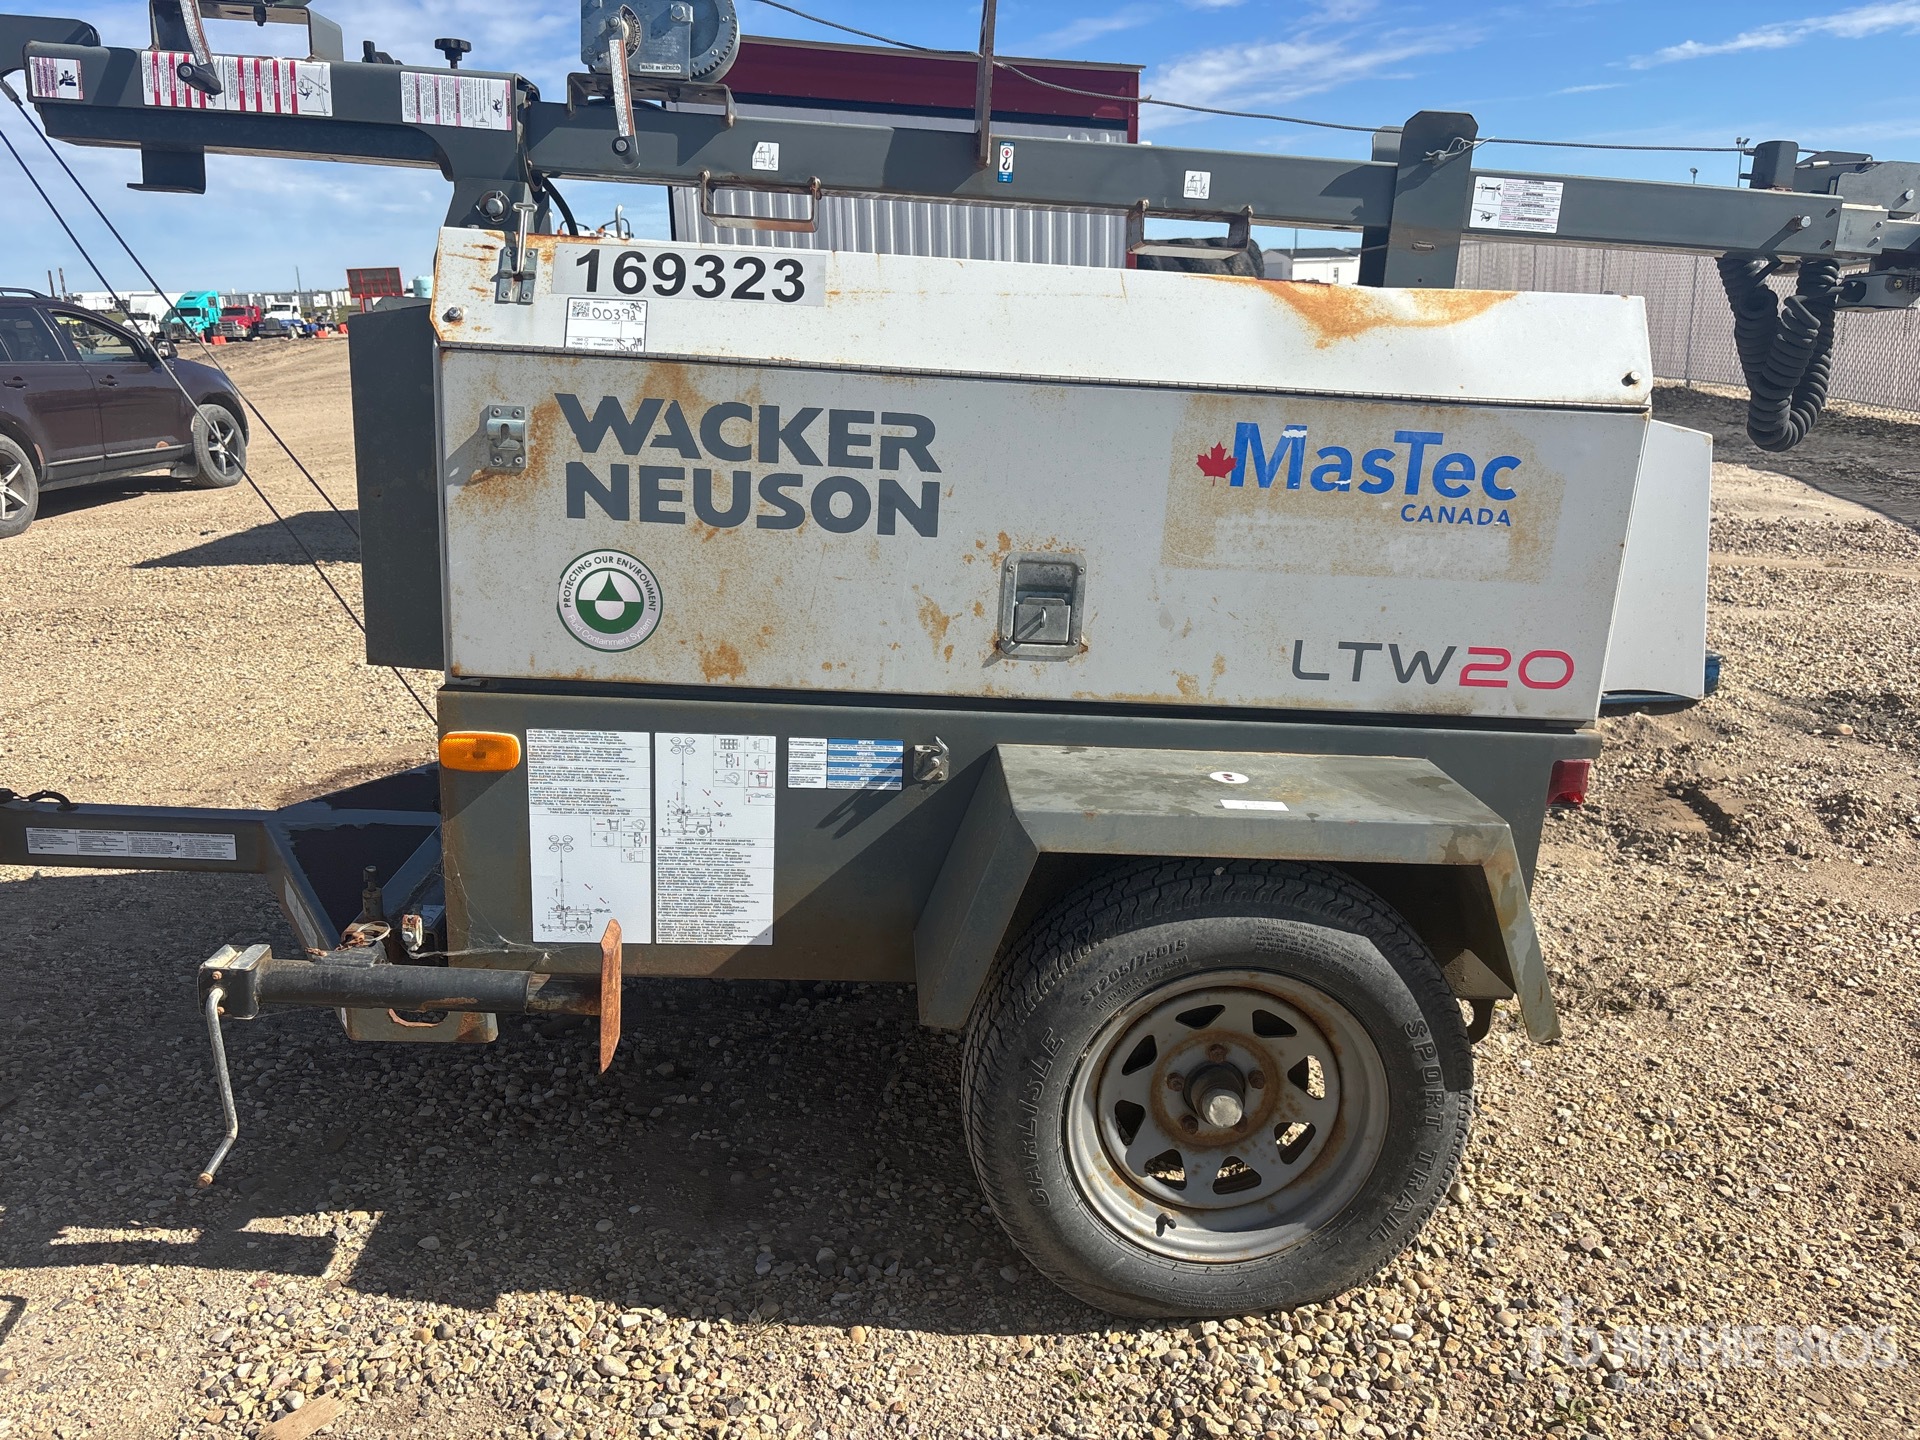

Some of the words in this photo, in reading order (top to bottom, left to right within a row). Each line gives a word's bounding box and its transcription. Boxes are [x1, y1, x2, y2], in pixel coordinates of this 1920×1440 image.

[632, 20, 640, 45] CAUTION
[576, 248, 806, 302] 169323
[554, 392, 942, 473] WACKER
[1230, 422, 1522, 501] MasTec
[565, 461, 941, 538] NEUSON
[1400, 504, 1512, 527] CANADA
[563, 560, 592, 608] PROTECTING
[594, 555, 613, 564] OUR
[616, 558, 656, 612] ENVIRONMENT
[568, 614, 582, 632] Fluid
[582, 630, 630, 646] Containment
[630, 618, 652, 640] System
[1292, 640, 1575, 690] LTW20
[1288, 922, 1320, 934] WARNING
[1080, 939, 1188, 1006] ST205/75D15
[1404, 1018, 1445, 1132] SPORT
[1016, 1026, 1065, 1208] CARLISLE
[1366, 1150, 1438, 1242] TRAIL
